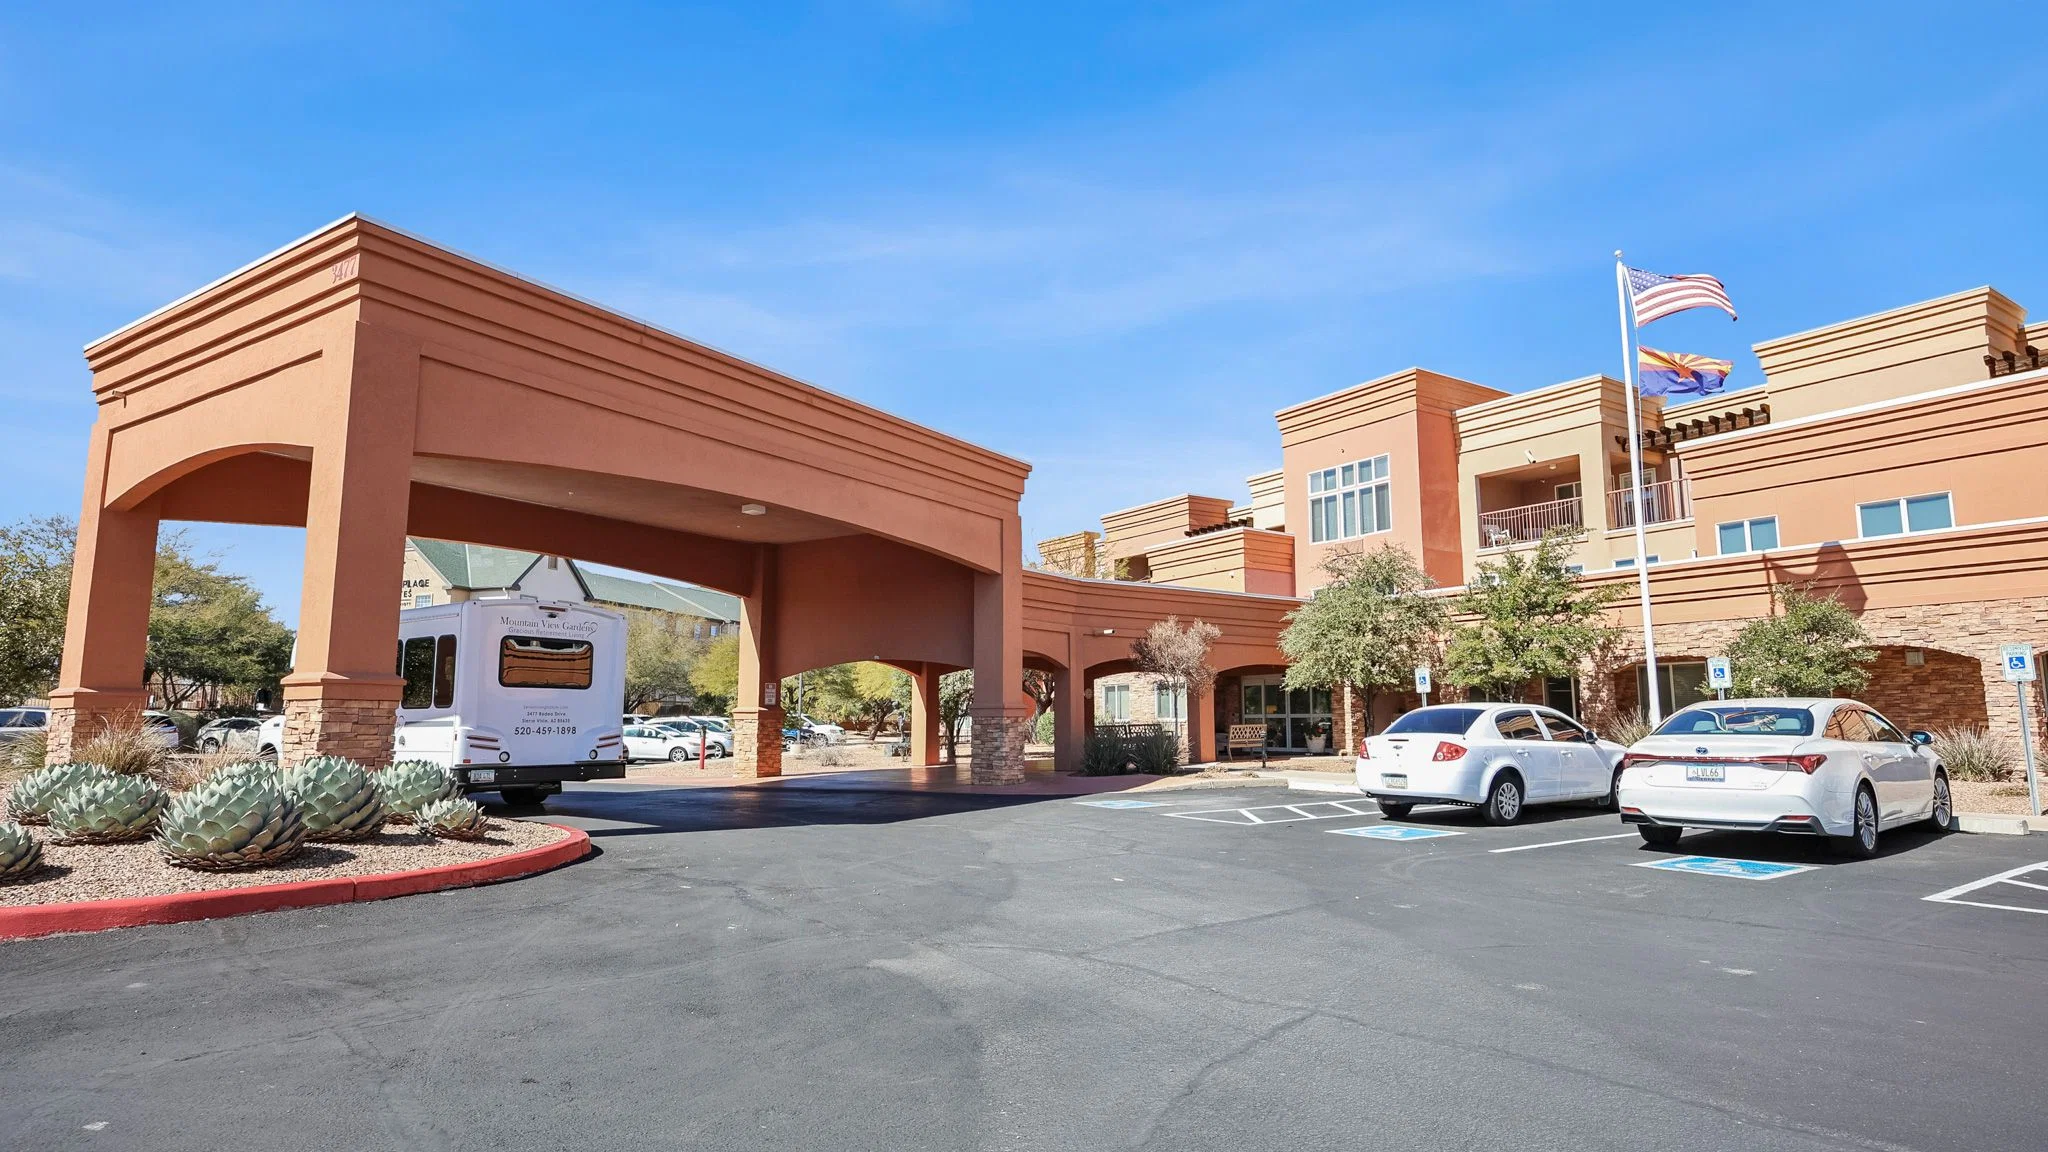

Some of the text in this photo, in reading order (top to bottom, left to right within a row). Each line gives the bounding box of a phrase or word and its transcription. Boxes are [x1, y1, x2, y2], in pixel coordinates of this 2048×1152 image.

[332, 255, 357, 284] 3477
[500, 616, 594, 632] Mountain View Gardens
[508, 626, 535, 635] Gracious
[535, 629, 567, 637] Retirement
[514, 726, 577, 736] 520-459-1898
